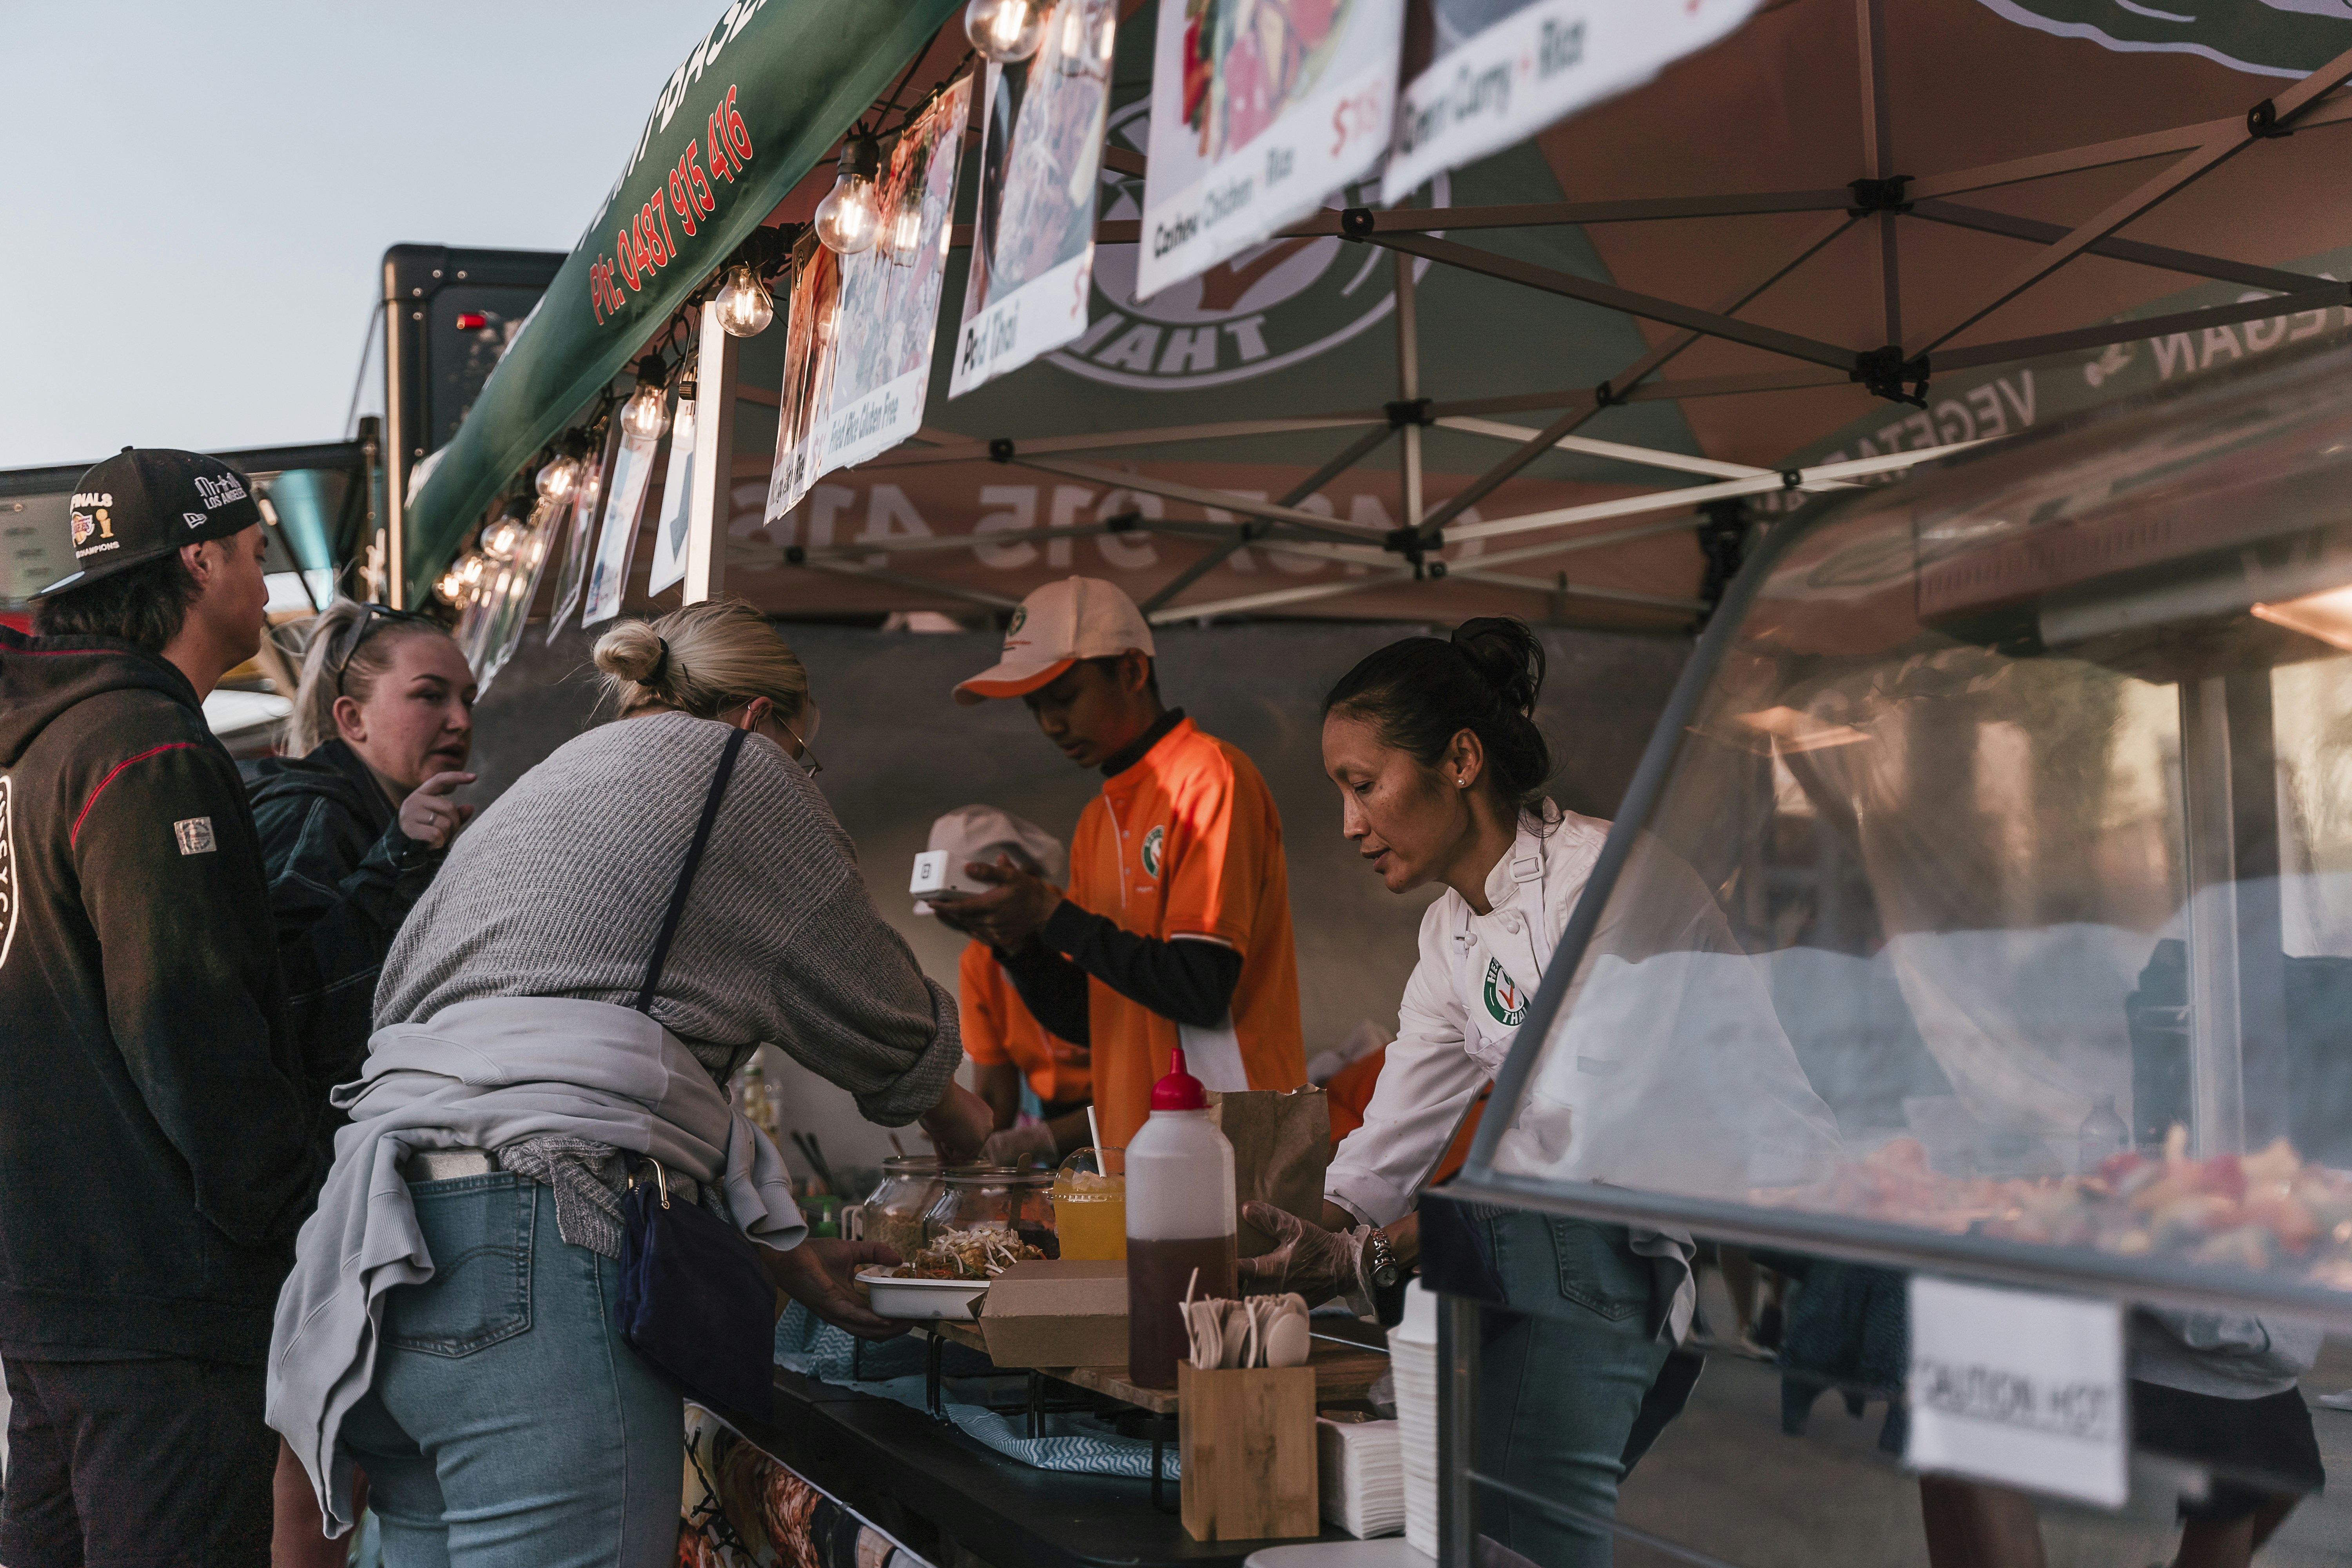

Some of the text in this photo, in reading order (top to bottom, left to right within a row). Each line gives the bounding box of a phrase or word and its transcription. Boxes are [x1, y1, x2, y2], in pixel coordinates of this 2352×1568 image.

[590, 253, 626, 326] Ph:
[617, 187, 677, 291] 0487
[669, 138, 715, 236] 915
[708, 84, 753, 183] 416
[961, 298, 1020, 376] Pad Thai
[828, 390, 899, 455] Fried Rice Gluten Free
[795, 452, 805, 485] Rice
[203, 495, 222, 510] LOS
